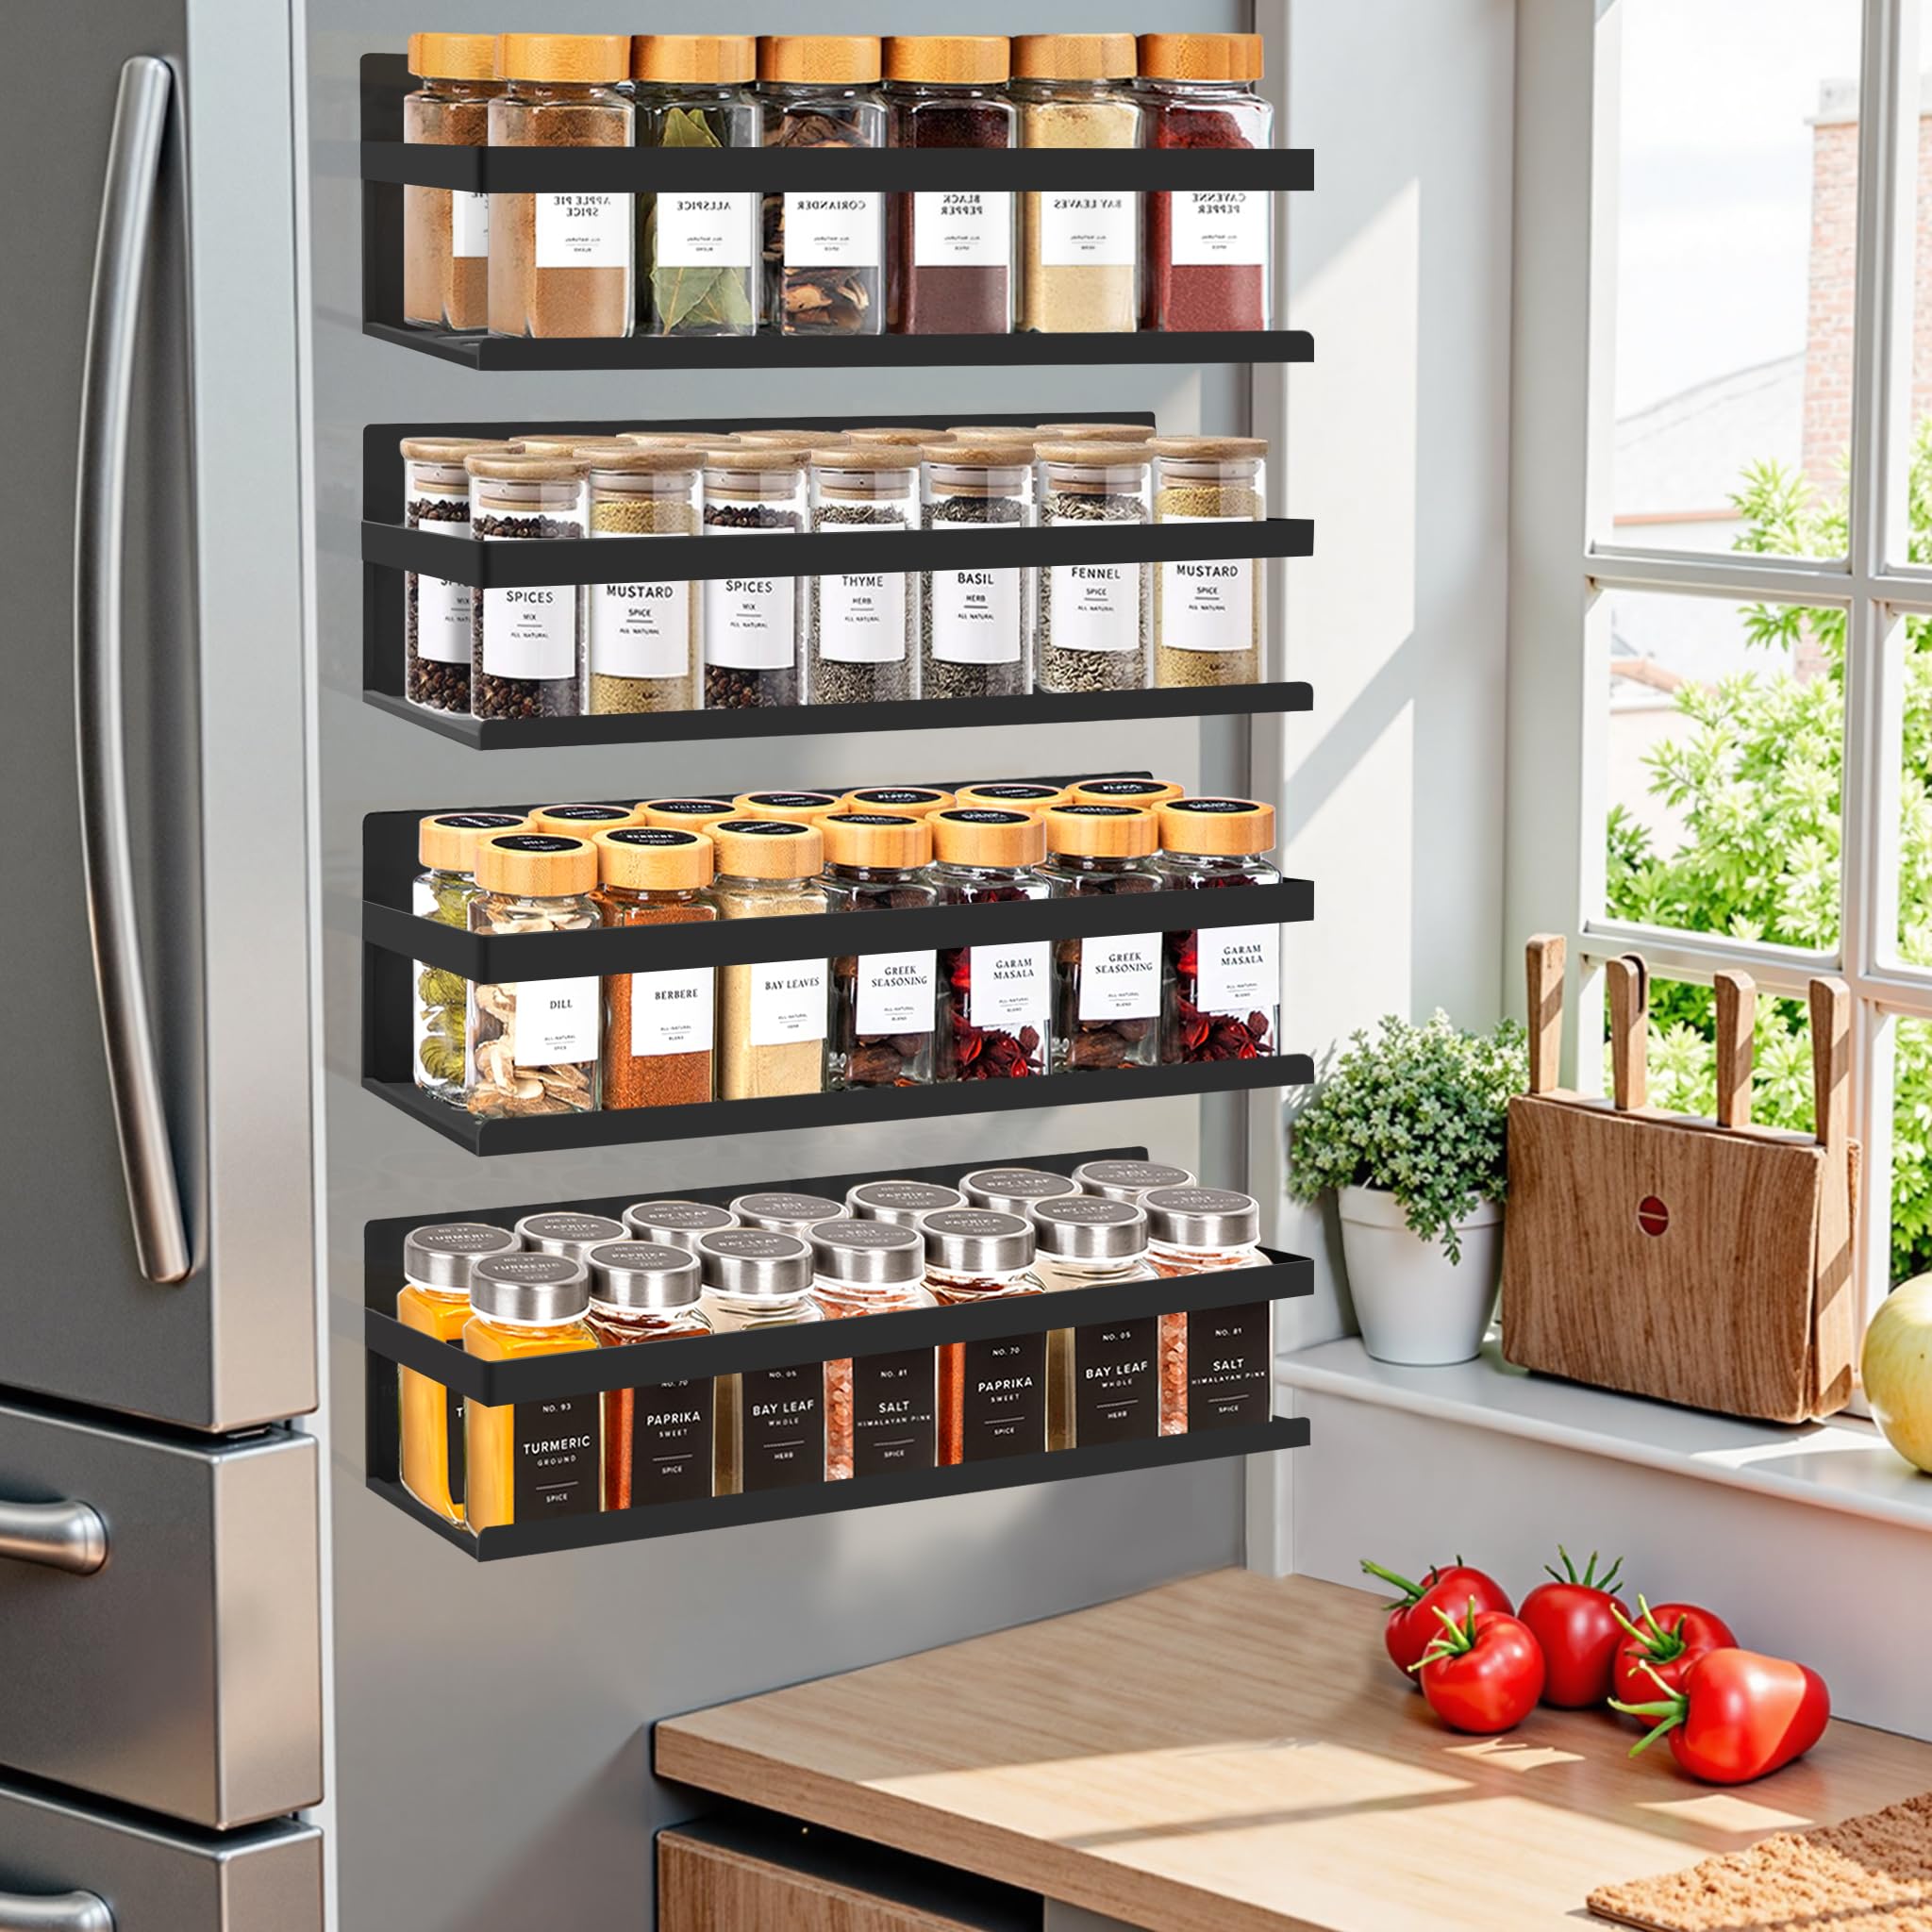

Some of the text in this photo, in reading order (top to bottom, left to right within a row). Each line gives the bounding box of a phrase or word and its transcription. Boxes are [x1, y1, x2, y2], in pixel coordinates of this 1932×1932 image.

[1072, 567, 1120, 579] FENNEL
[1176, 564, 1238, 577] MUSTARD
[841, 575, 884, 588] THYME
[958, 572, 993, 585] BASIL
[607, 585, 674, 599] MUSTARD
[725, 580, 773, 593] SPICES
[507, 591, 553, 604] SPICES
[1224, 944, 1261, 955] GARAM
[995, 958, 1032, 969] GARAM
[1108, 953, 1141, 962] GREEK
[1222, 955, 1263, 965] MASALA
[884, 966, 916, 975] GREEK
[993, 969, 1034, 979] MASALA
[1095, 962, 1153, 974] SEASONING
[765, 976, 820, 991] BAY LEAVES
[872, 975, 927, 988] SEASONING
[655, 989, 697, 1000] BERBERE
[550, 999, 573, 1009] DILL
[1086, 1360, 1148, 1379] BAY LEAF
[1213, 1358, 1243, 1372] SALT
[978, 1376, 1032, 1392] PAPRIKA
[753, 1399, 814, 1416] BAY LEAF
[879, 1401, 909, 1413] SALT
[647, 1411, 700, 1425] PAPRIKA
[524, 1435, 591, 1456] TURMERIC
